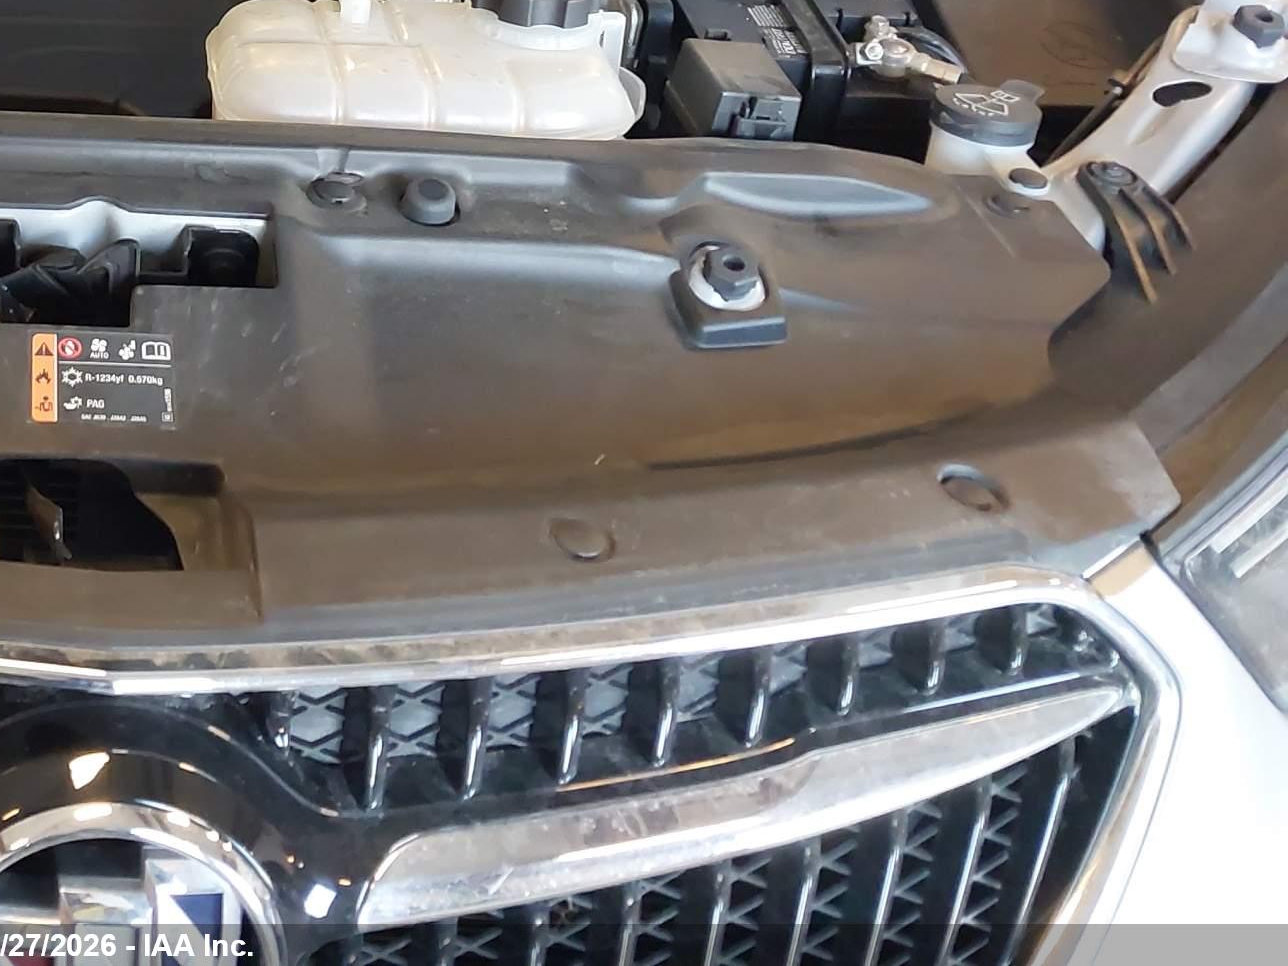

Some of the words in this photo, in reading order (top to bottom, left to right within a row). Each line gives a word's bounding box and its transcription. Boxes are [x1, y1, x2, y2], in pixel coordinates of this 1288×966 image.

[90, 351, 109, 360] AUTO
[85, 373, 124, 384] R-1234yf
[86, 399, 105, 409] PAG
